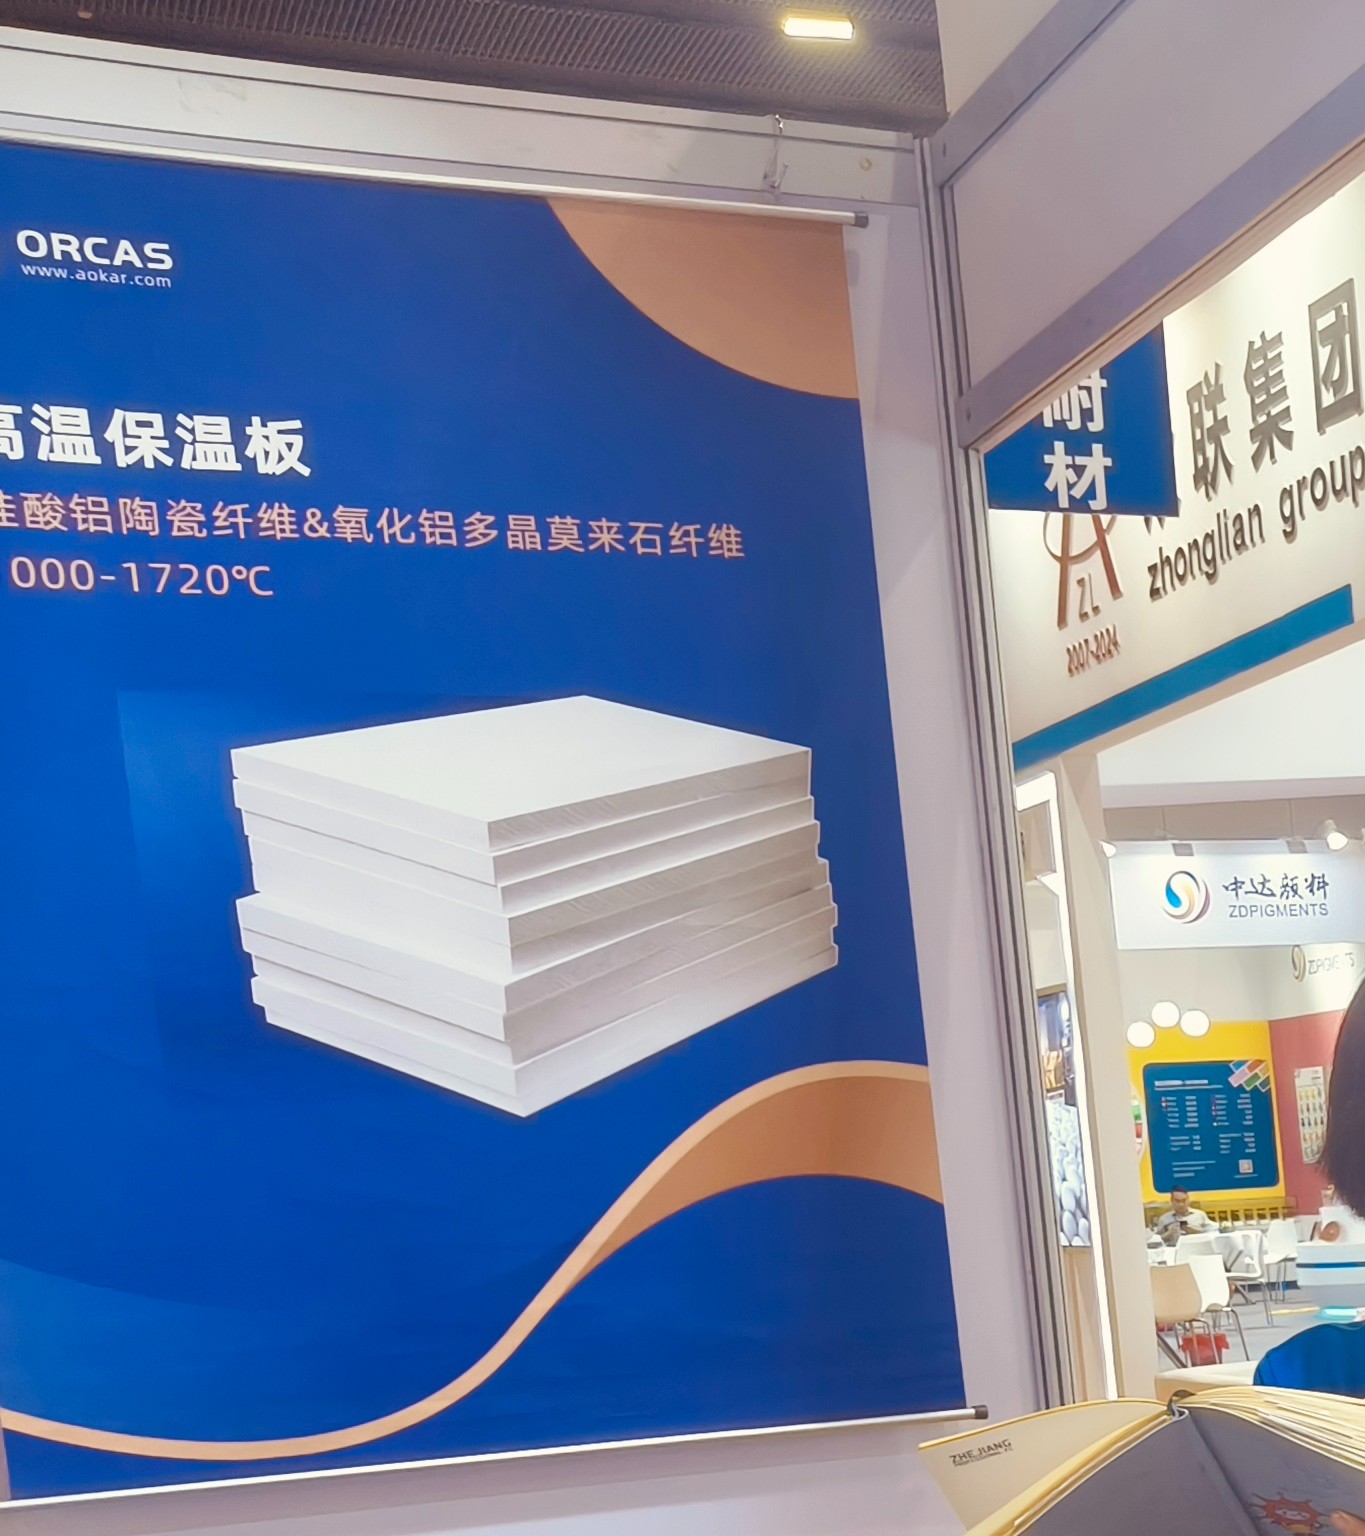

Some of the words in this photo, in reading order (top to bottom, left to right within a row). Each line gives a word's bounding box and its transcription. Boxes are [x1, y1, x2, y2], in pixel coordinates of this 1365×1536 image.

[17, 229, 173, 271] ORCAS
[20, 264, 172, 288] www.aokar.com
[1147, 503, 1266, 602] zhonglian
[1229, 903, 1329, 918] ZDPIGMENTS
